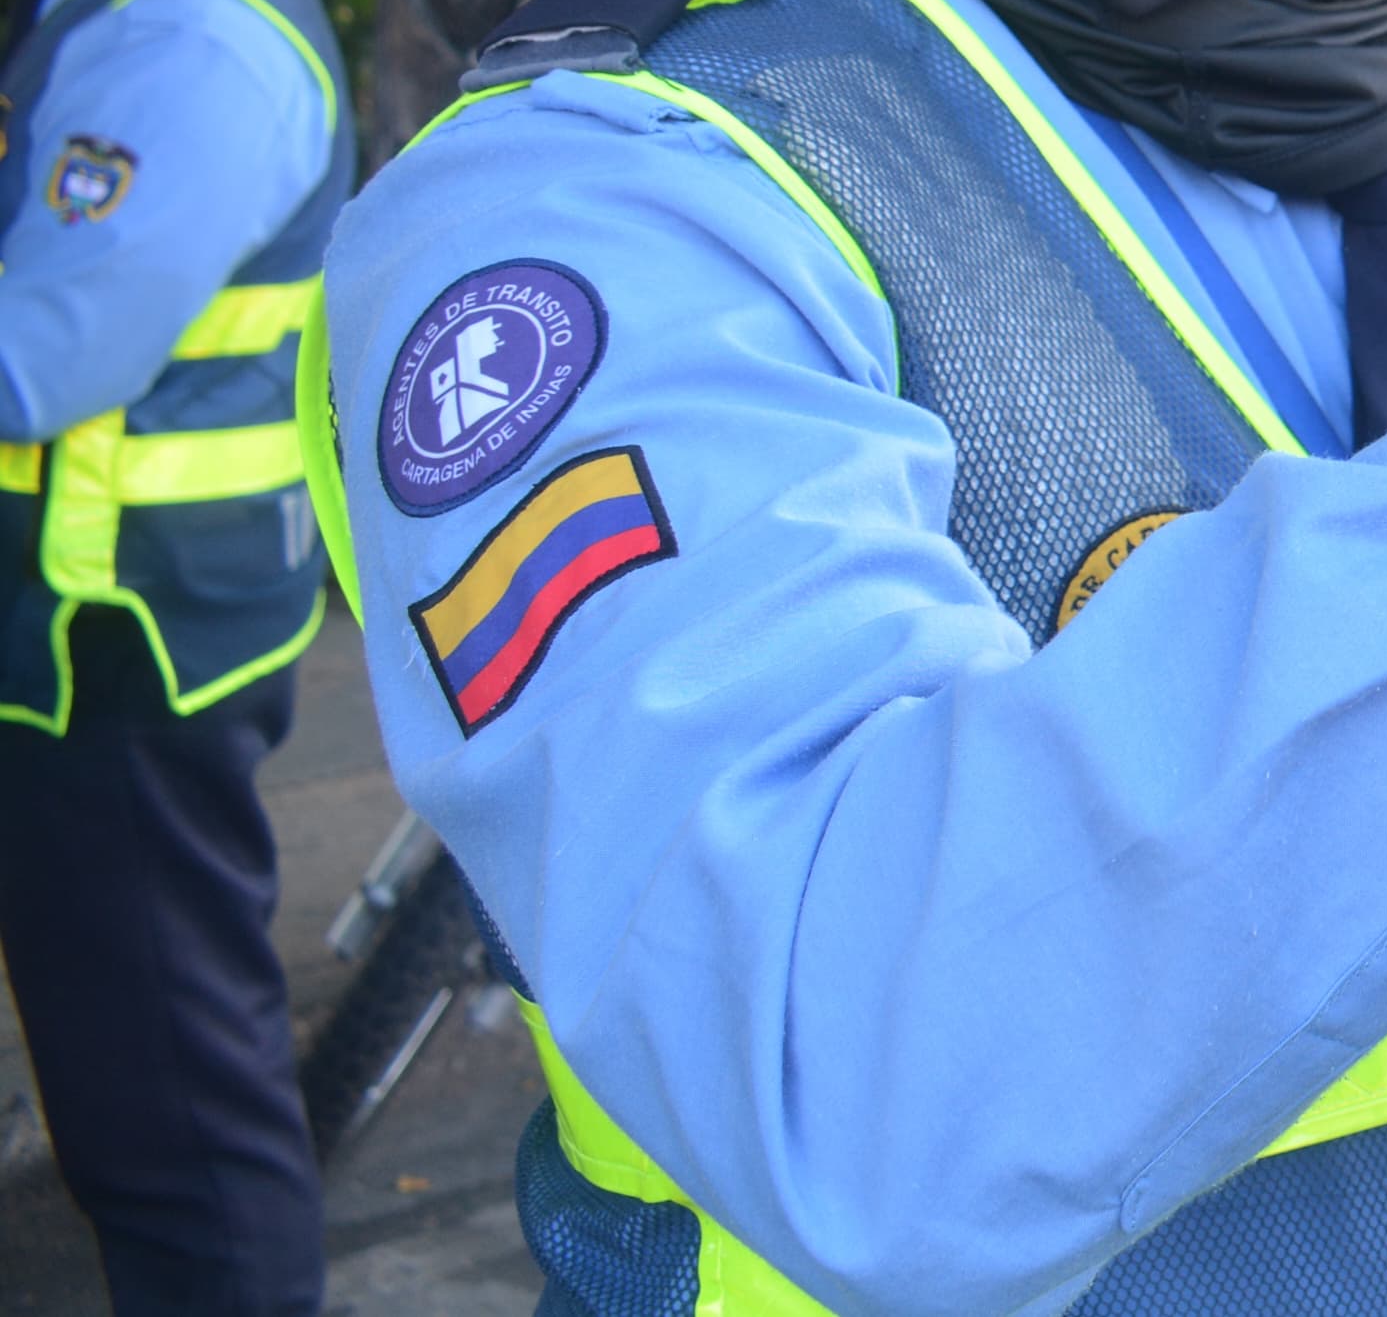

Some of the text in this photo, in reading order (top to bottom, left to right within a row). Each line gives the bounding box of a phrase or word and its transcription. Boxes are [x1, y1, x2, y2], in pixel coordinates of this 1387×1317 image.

[393, 283, 573, 447] AGENTES DE TRANSITO
[401, 363, 573, 486] CARTAGENA DE INDIAS
